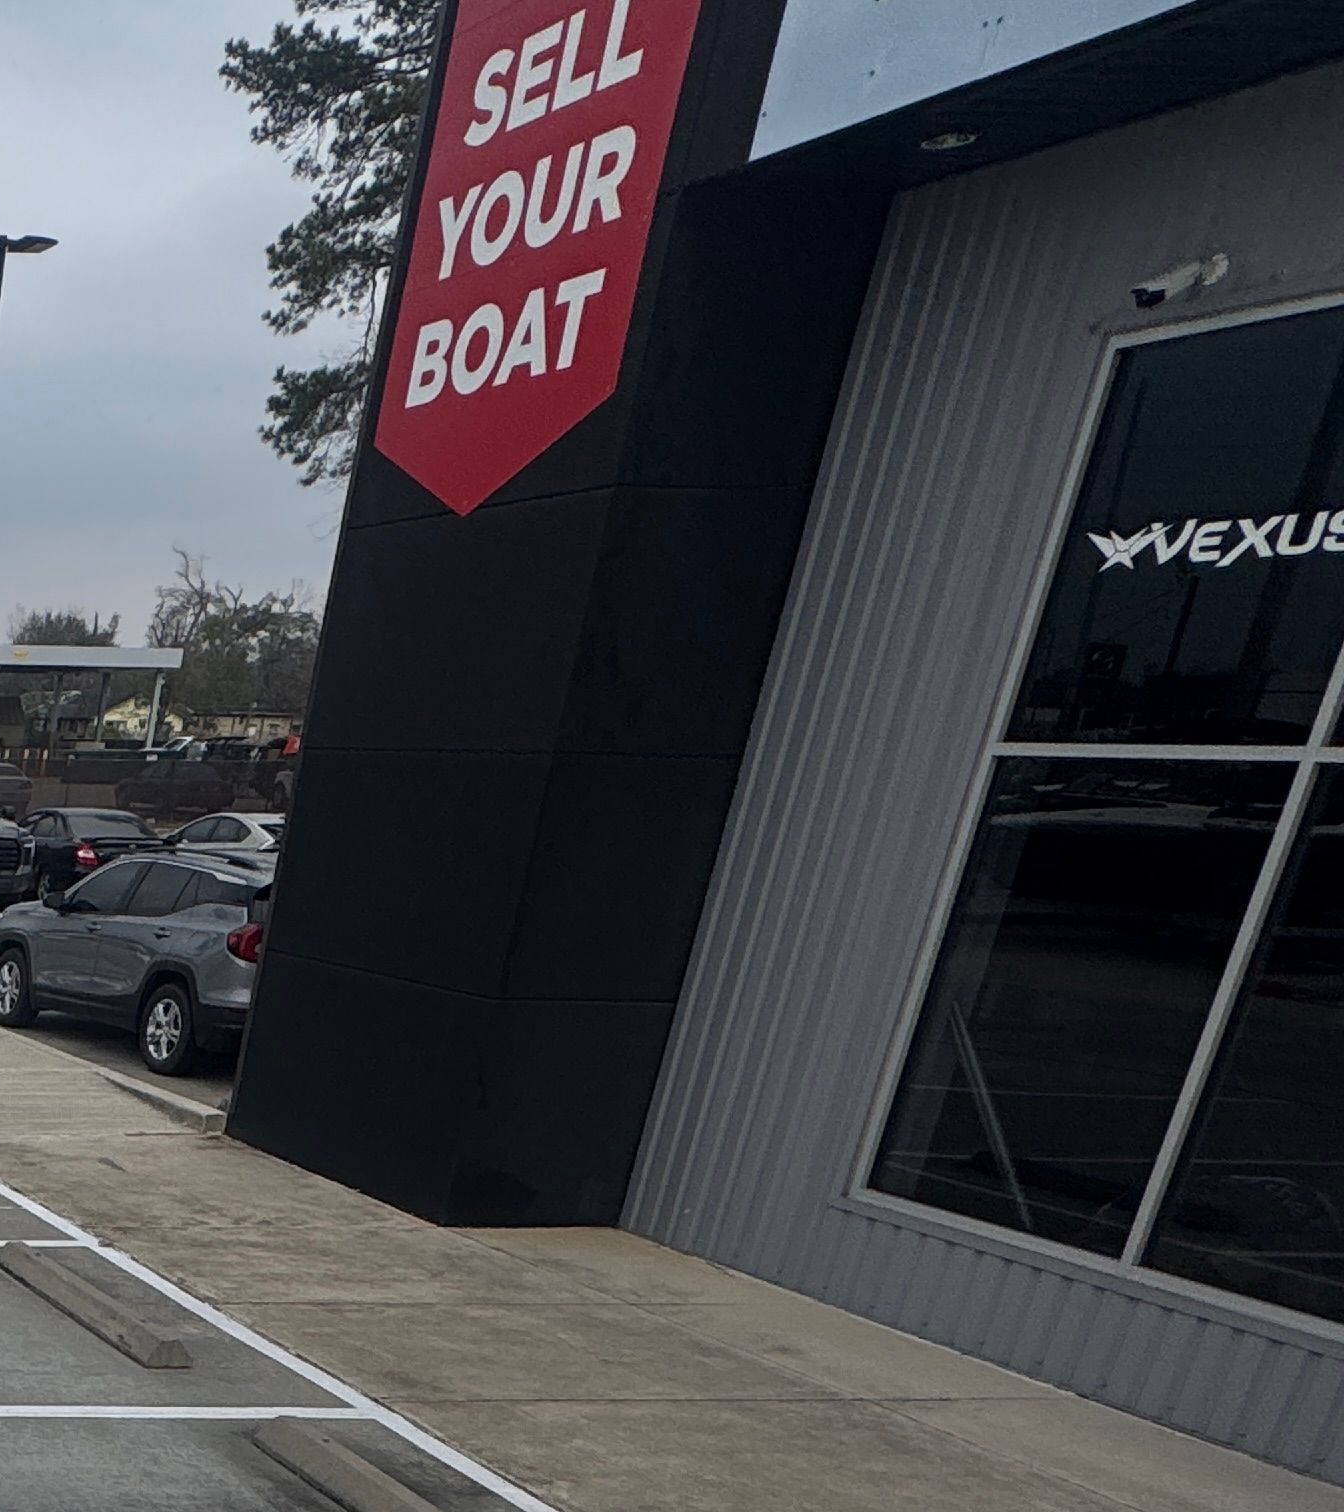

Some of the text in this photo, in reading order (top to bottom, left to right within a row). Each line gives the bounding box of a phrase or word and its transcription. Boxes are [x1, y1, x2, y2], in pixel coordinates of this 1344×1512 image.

[464, 0, 644, 147] SELL
[438, 125, 637, 281] YOUR
[405, 268, 607, 409] BOAT
